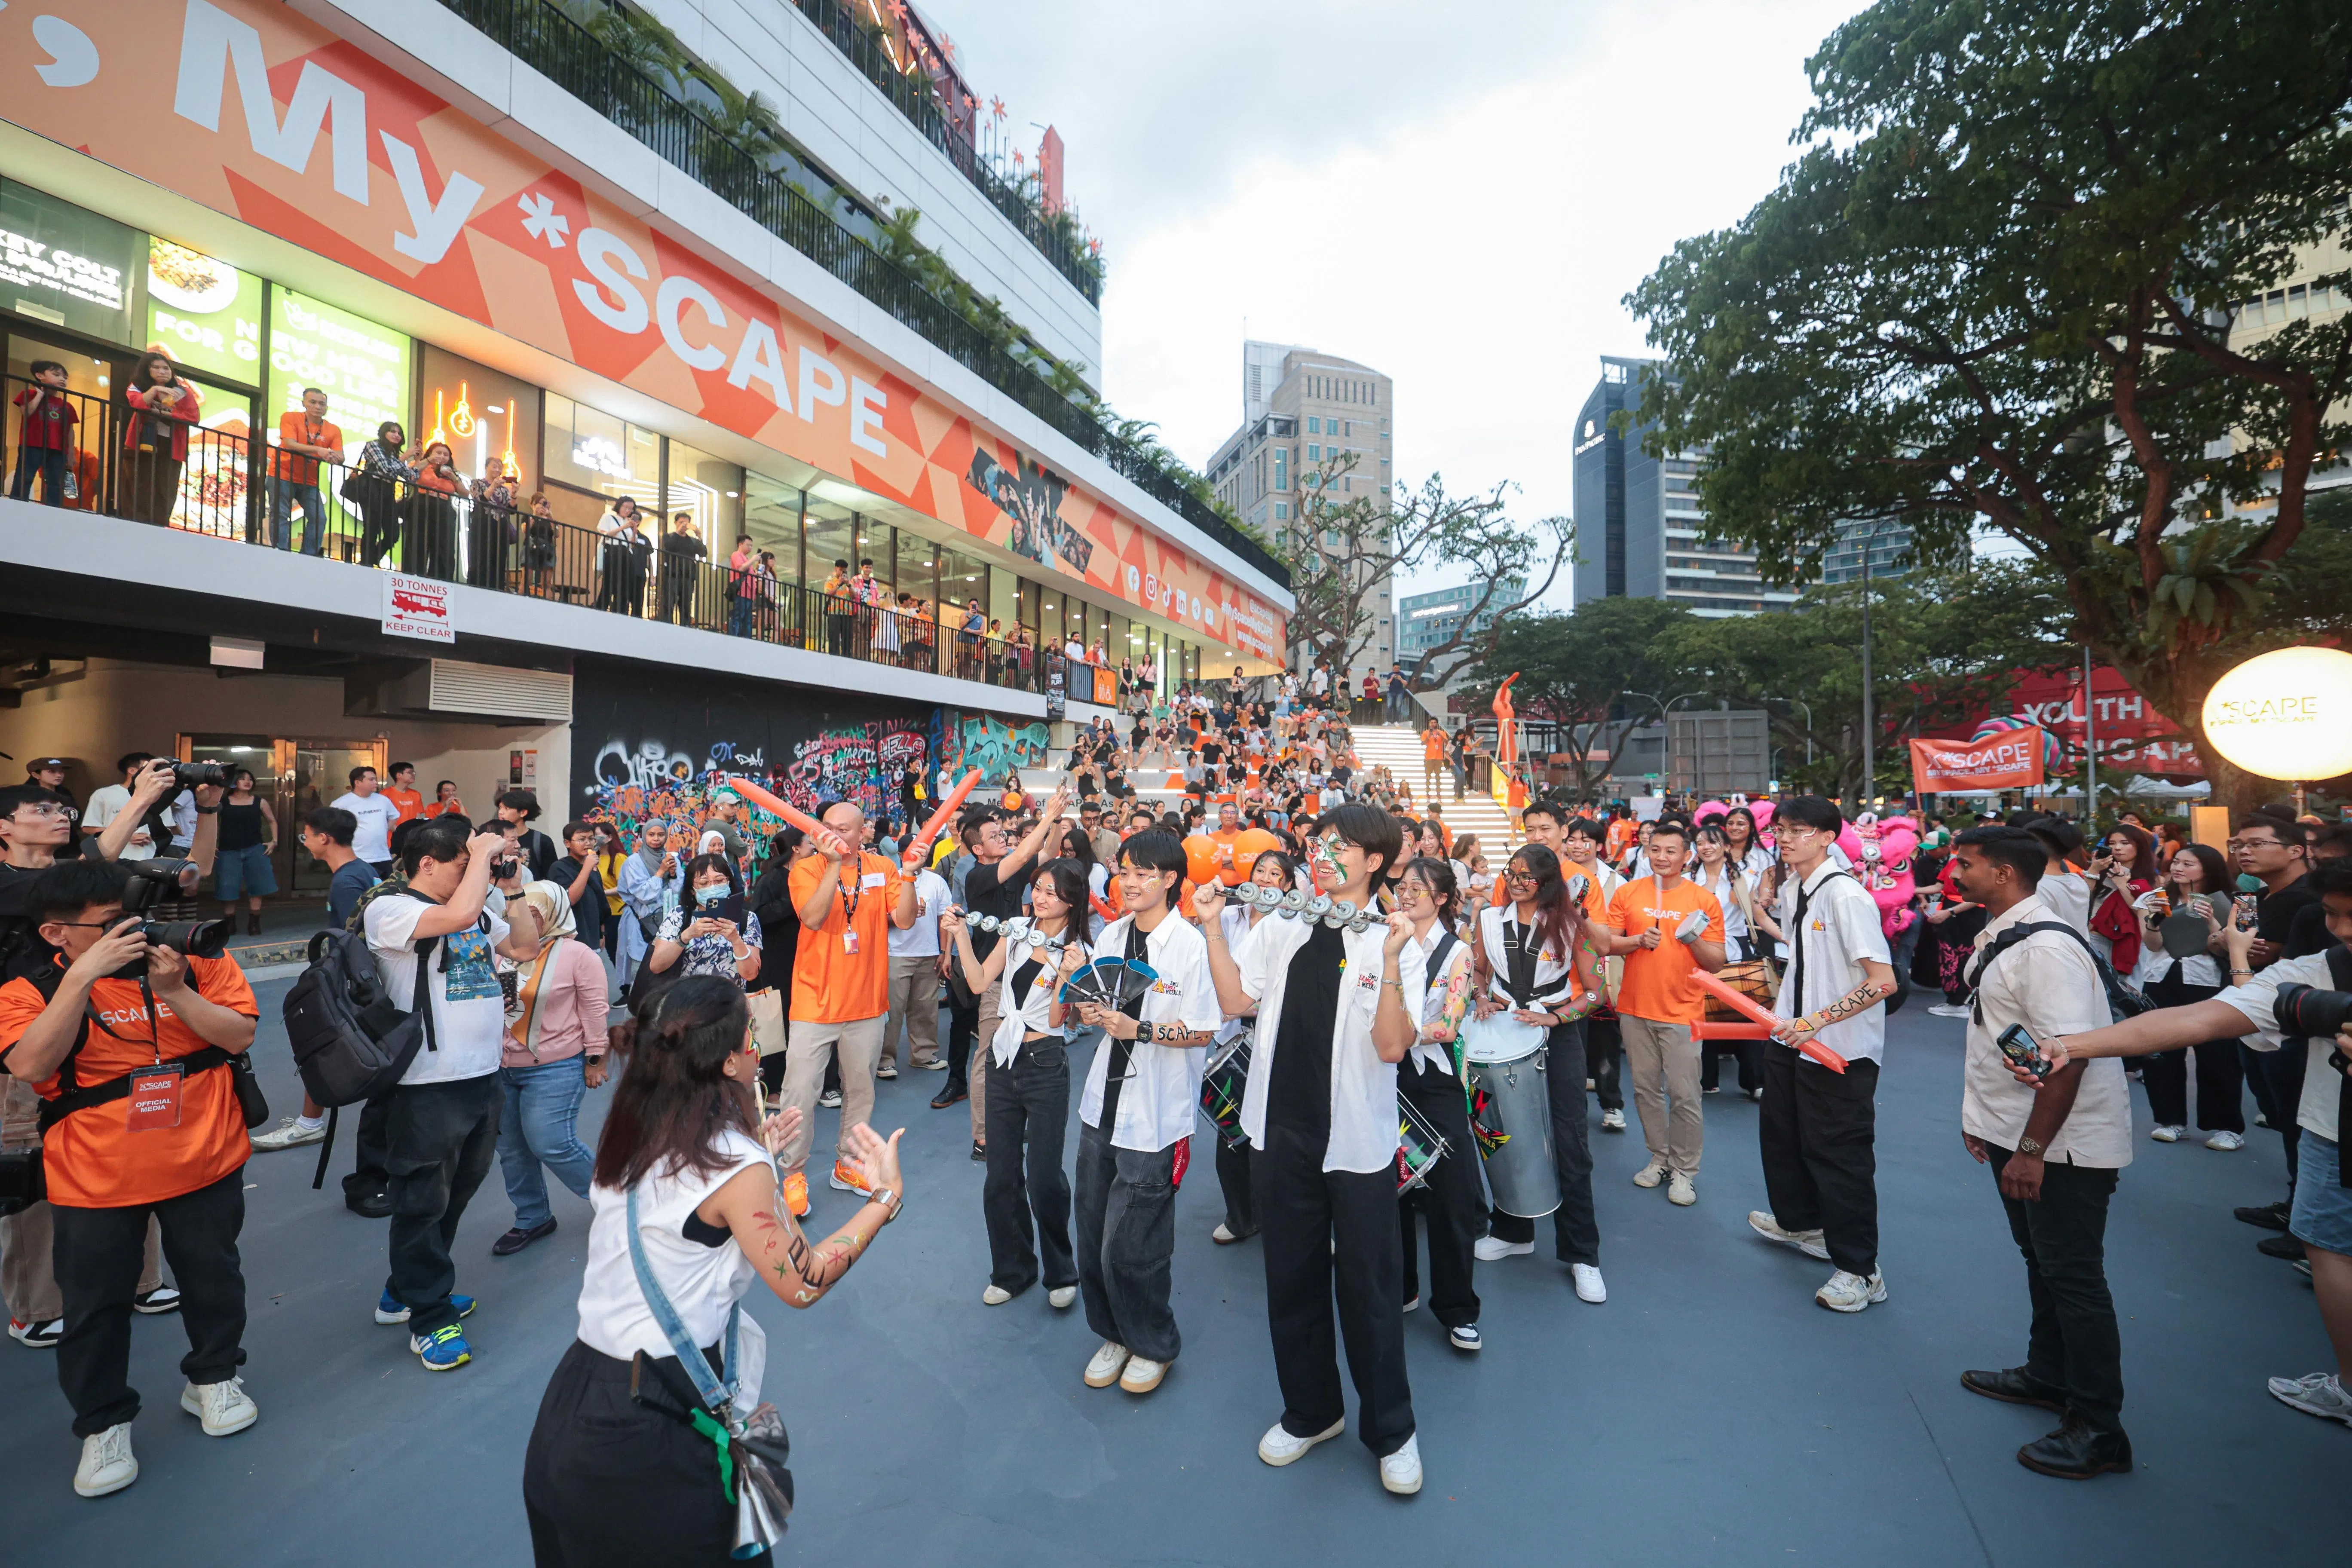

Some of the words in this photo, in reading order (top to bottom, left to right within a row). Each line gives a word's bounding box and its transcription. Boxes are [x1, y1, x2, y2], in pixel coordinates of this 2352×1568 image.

[174, 0, 485, 264] My
[155, 310, 224, 352] FOR
[391, 577, 403, 587] 30
[407, 580, 447, 595] TONNES
[386, 622, 413, 632] KEEP
[417, 626, 451, 638] CLEAR
[1036, 799, 1046, 807] of
[1368, 973, 1378, 982] SMU
[1830, 983, 1877, 1017] SCAPE
[135, 1098, 172, 1108] OFFICIAL
[140, 1104, 166, 1113] MEDIA
